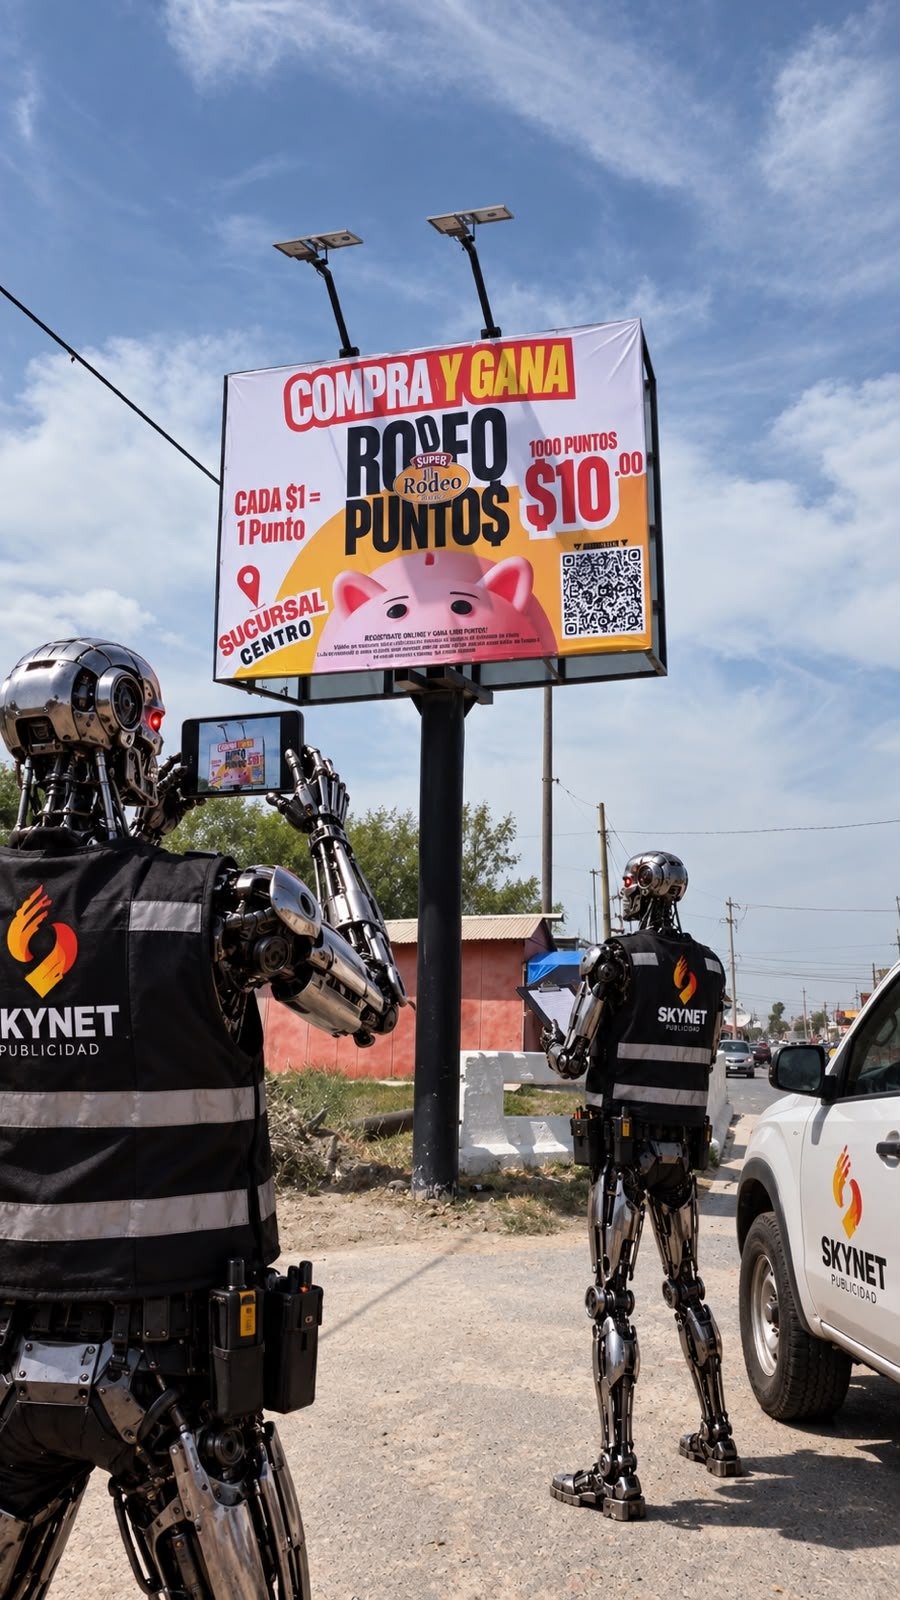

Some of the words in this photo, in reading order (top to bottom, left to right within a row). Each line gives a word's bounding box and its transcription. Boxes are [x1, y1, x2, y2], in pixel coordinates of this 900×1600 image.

[290, 358, 433, 426] COMPRA
[439, 353, 464, 402] Y
[470, 344, 569, 399] GANA
[529, 438, 562, 458] 1000
[564, 431, 618, 454] PUNTOS
[404, 471, 462, 494] Rodeo
[234, 487, 282, 516] CADA
[286, 483, 305, 512] $1
[237, 519, 245, 546] 1
[249, 516, 305, 545] Punto
[218, 591, 326, 657] SUCURSAL
[240, 619, 312, 666] CENTRO
[0, 1005, 120, 1039] KYNET
[657, 1006, 707, 1025] SKYNET
[0, 1043, 100, 1057] PUBLICIDAD
[821, 1235, 887, 1290] SKYNET
[831, 1273, 877, 1304] PUBLICIDAD
